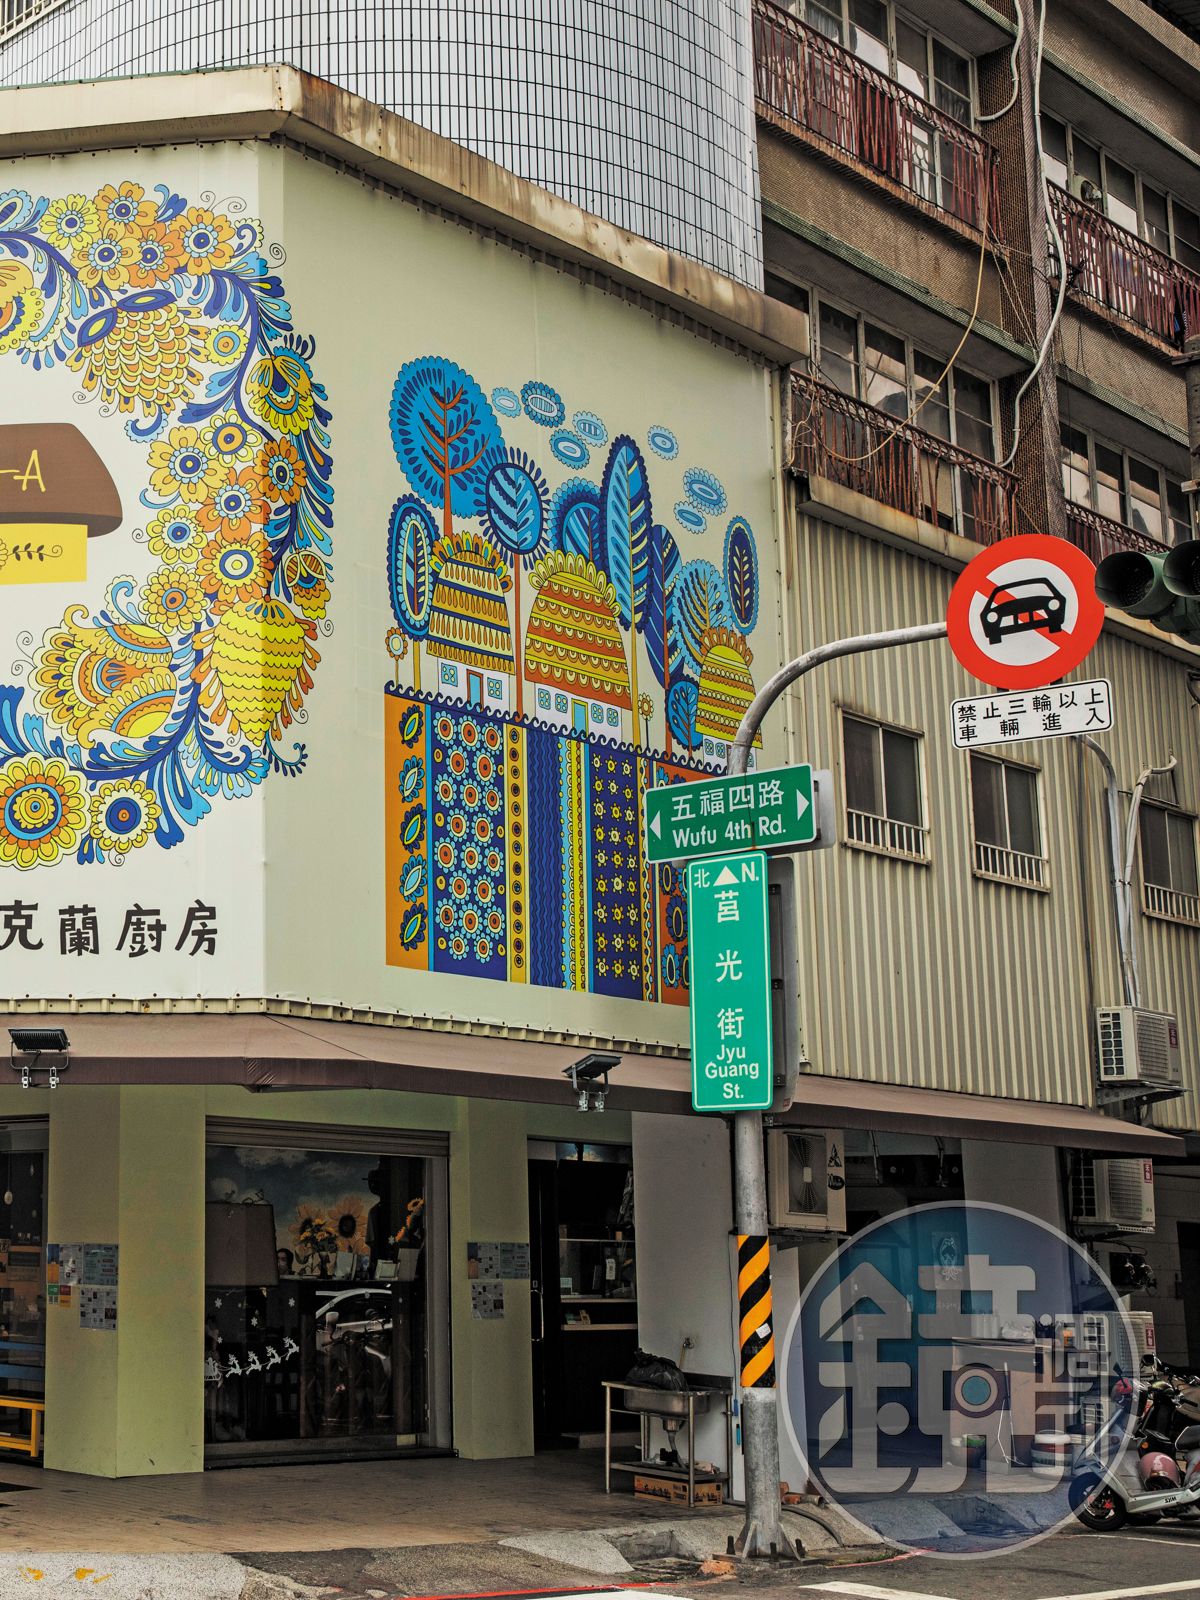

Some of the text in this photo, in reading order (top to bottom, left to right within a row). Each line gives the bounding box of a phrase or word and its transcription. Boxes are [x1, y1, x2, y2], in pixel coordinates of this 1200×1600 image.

[957, 688, 1104, 724] 禁止三輪以上
[959, 707, 1105, 743] 車輛進入
[670, 779, 785, 822] 五福四路
[672, 813, 787, 849] Wufu 4th Rd.
[693, 861, 760, 889] 北 N.
[713, 889, 745, 1041] 莒光街
[704, 1061, 760, 1080] Guang
[716, 1044, 746, 1064] Jyu
[722, 1082, 745, 1100] St.
